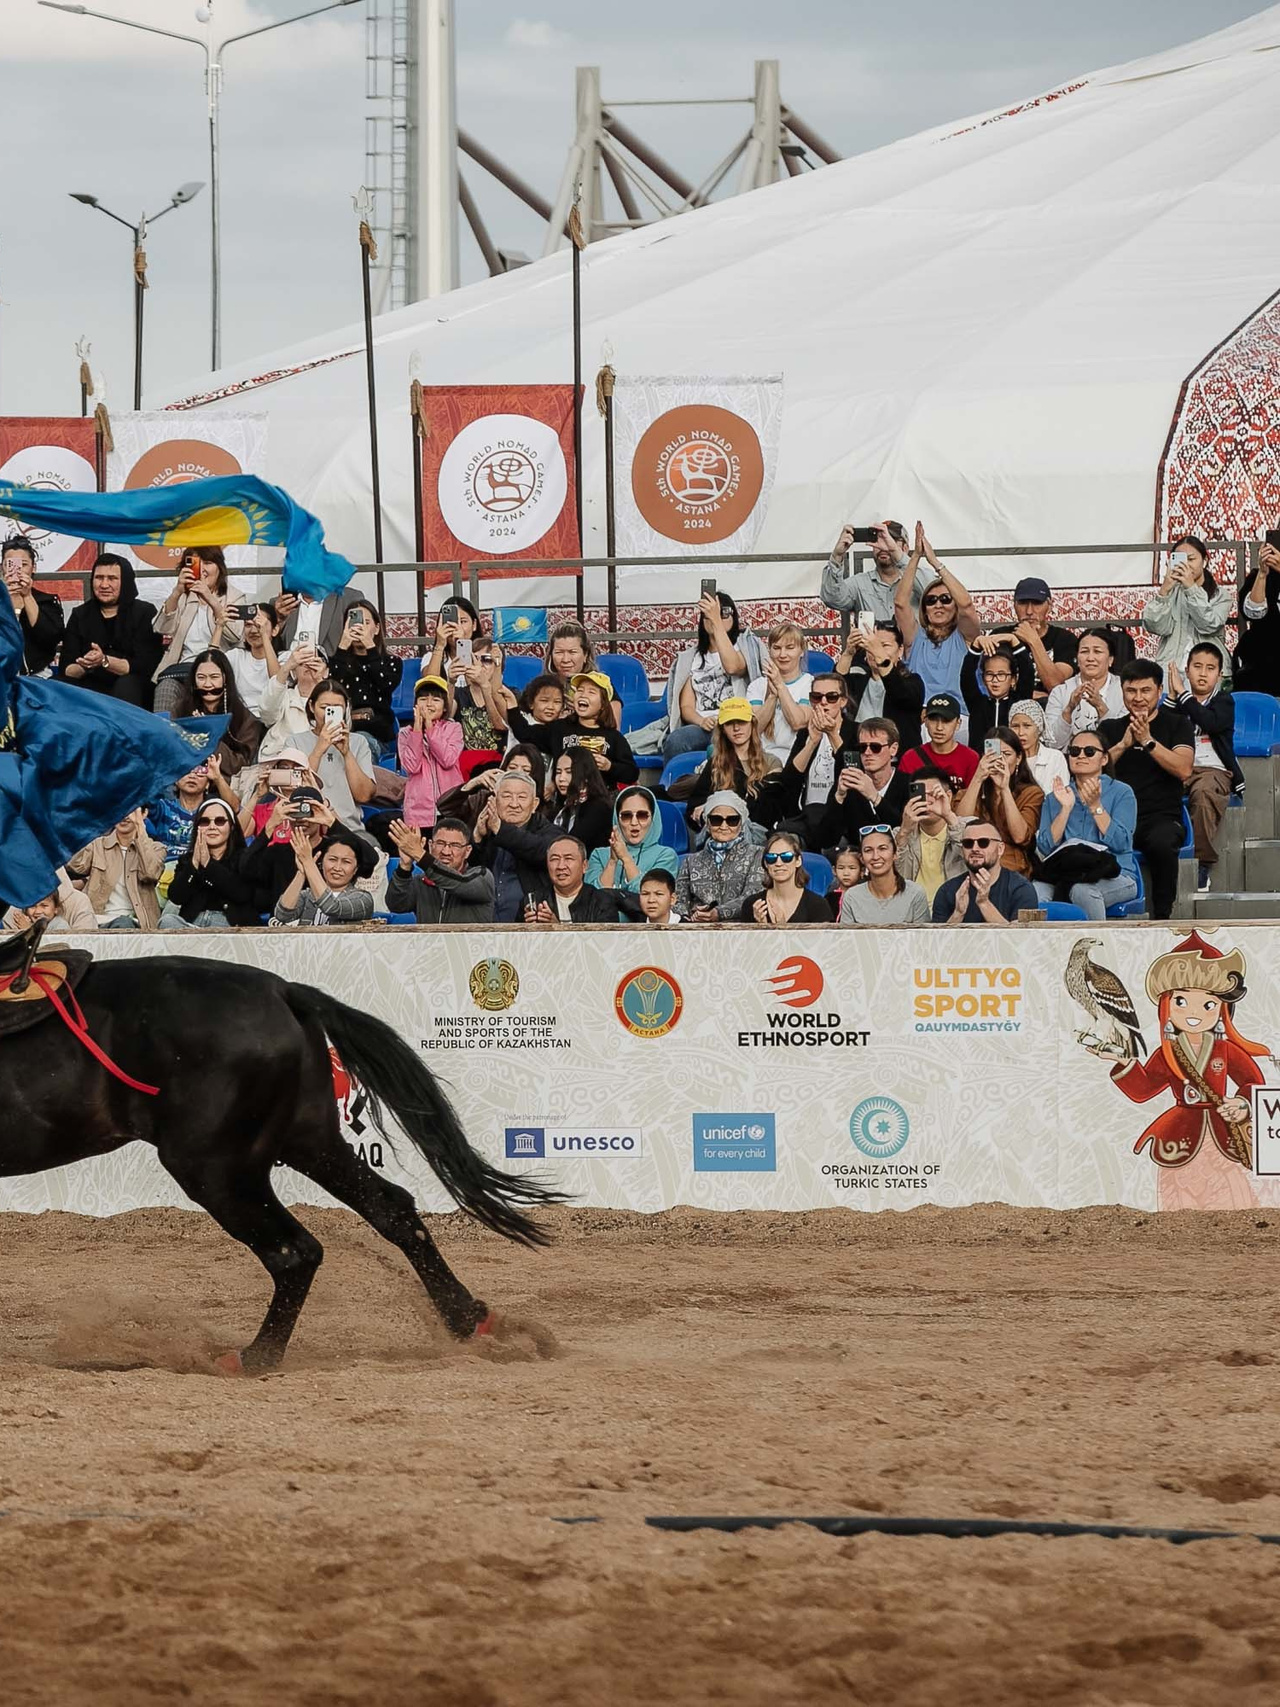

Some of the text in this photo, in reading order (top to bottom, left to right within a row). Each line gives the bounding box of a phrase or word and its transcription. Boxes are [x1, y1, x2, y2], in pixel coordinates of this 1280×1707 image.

[656, 430, 741, 498] 5th WORLD NOMAD GAMES
[38, 472, 72, 490] NOMAD
[148, 464, 215, 489] ORLD NOMA
[464, 440, 544, 508] 5th WORLD NOMAD GAMES
[676, 502, 721, 515] ASTANA
[482, 510, 525, 523] ASTANA
[684, 519, 712, 528] 2024
[490, 528, 516, 536] 2024
[914, 968, 1021, 988] ULTTYQ
[914, 994, 1022, 1018] SPORT
[434, 1016, 556, 1026] MINISTRY OF TOURISM
[766, 1013, 841, 1028] WORLD
[915, 1020, 1022, 1032] QAUYMDASTYĞY
[438, 1027, 552, 1038] AND SPORTS OF THE
[738, 1031, 870, 1046] ETHNOSPORT
[420, 1038, 571, 1049] REPUBLIC OF KAZAKHSTAN
[1262, 1098, 1280, 1120] W
[703, 1125, 746, 1140] unicef
[553, 1134, 634, 1150] unesco
[704, 1148, 766, 1160] for every child
[821, 1165, 940, 1175] ORGANIZATION OF
[834, 1178, 928, 1188] TURKIC STATES
